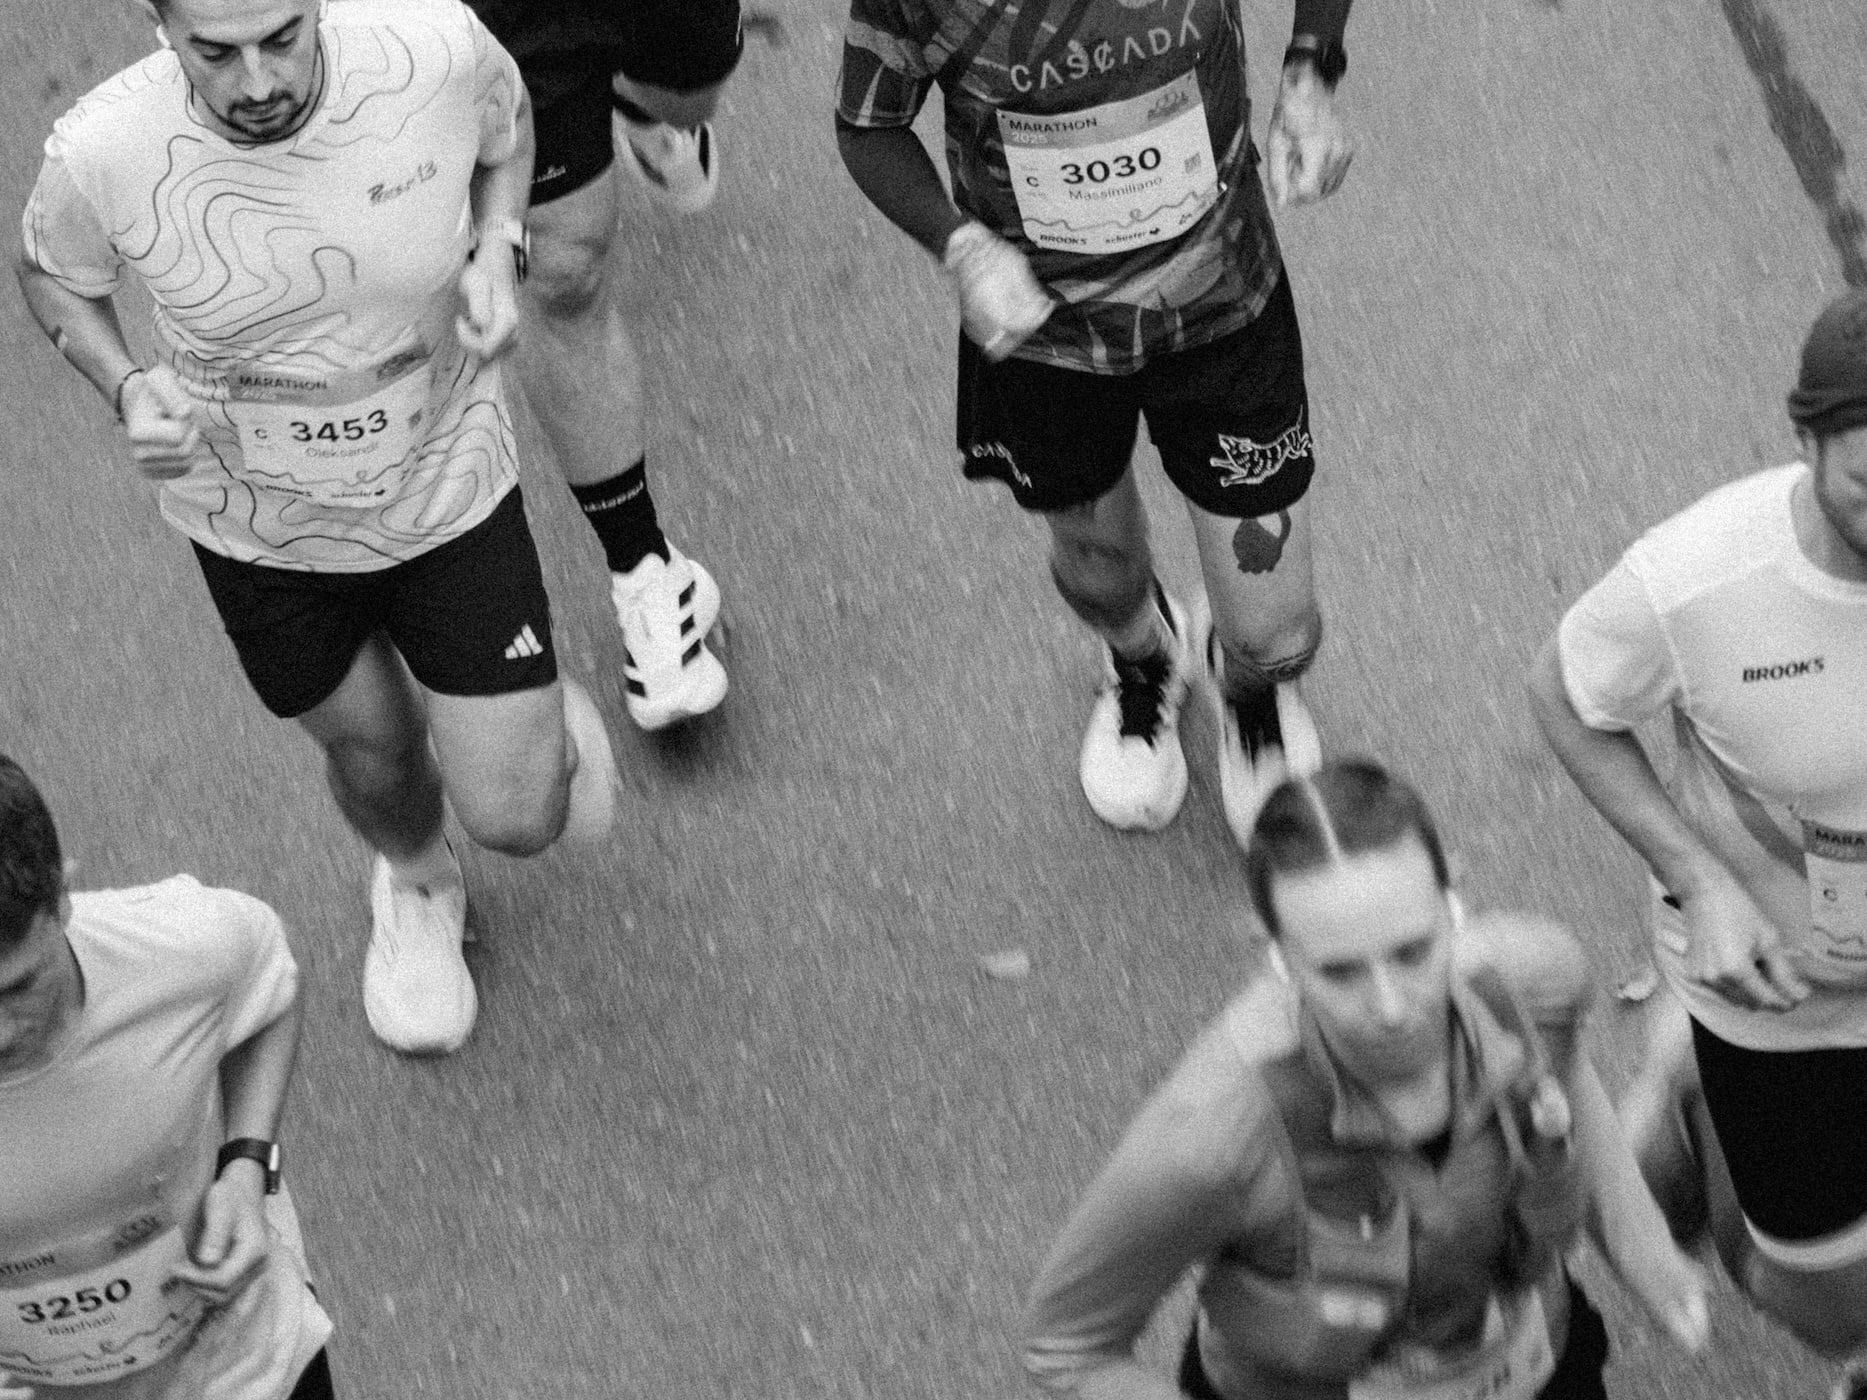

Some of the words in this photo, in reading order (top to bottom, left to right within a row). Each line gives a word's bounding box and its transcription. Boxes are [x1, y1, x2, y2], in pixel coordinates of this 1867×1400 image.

[1009, 118, 1098, 133] MARATHON
[1061, 147, 1161, 185] 3030
[1026, 175, 1039, 188] C
[1069, 176, 1162, 201] Massimiliano
[1039, 234, 1088, 245] BROOKS
[239, 375, 328, 391] MARATHON
[254, 428, 268, 440] C
[289, 409, 388, 442] 3453
[1742, 657, 1824, 683] BROOKS
[18, 1279, 132, 1323] 3250
